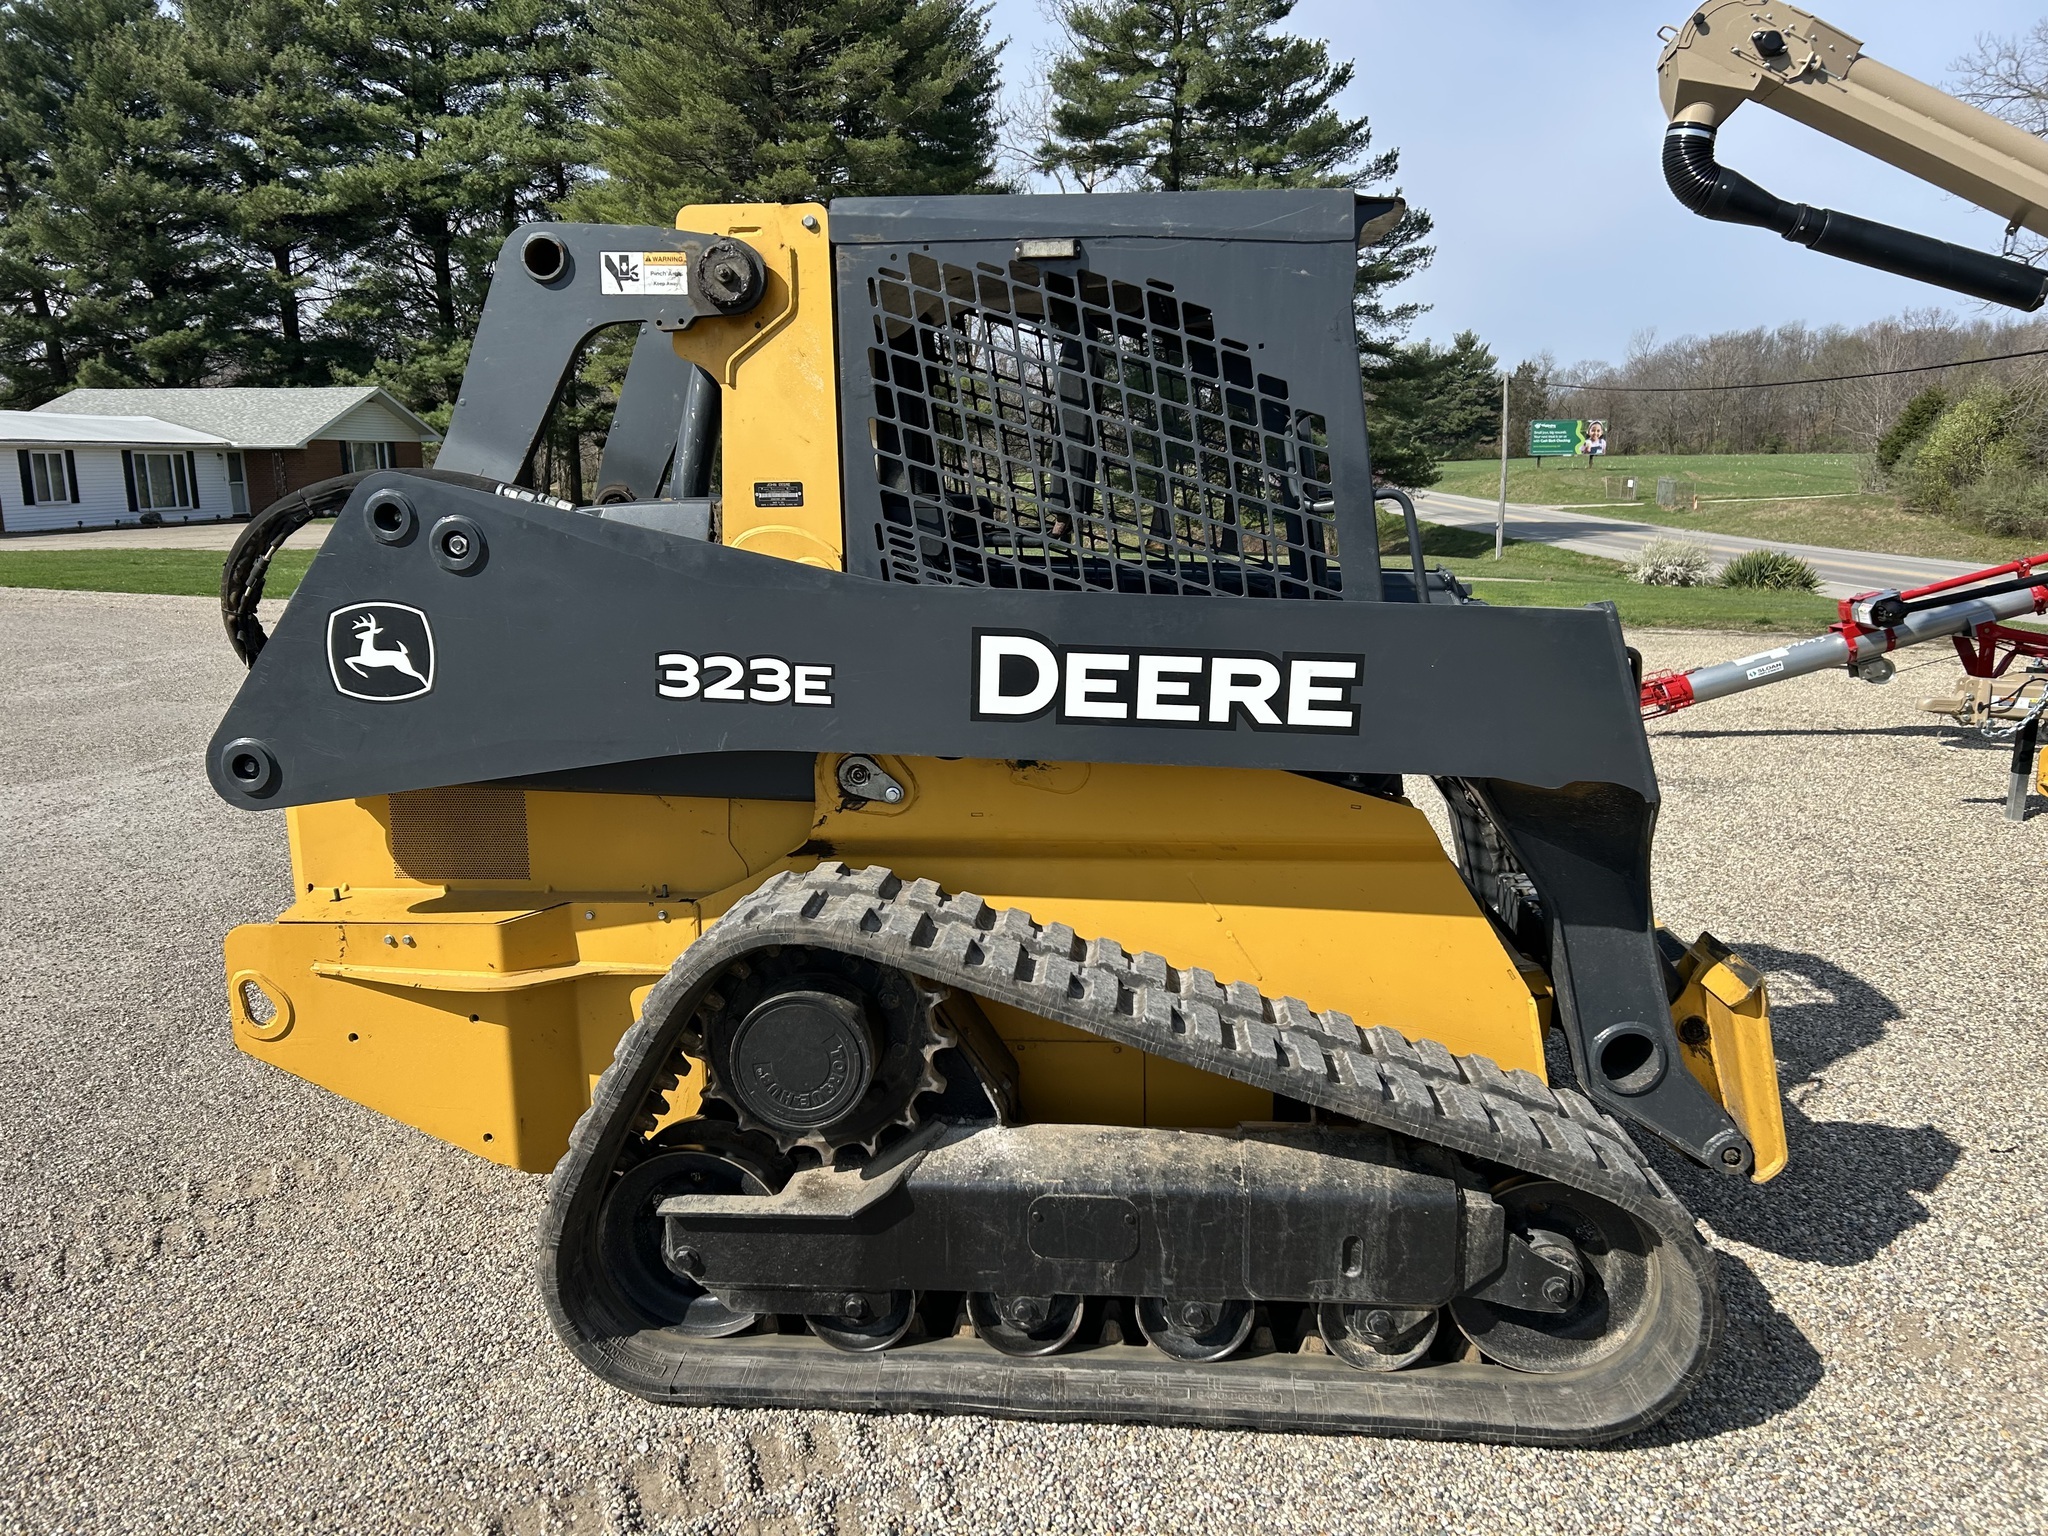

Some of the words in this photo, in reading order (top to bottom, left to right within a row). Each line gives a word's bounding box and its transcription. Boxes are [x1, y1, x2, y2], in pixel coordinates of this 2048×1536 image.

[659, 654, 831, 704] 323E
[980, 636, 1356, 726] DEERE
[1758, 663, 1781, 672] SLOAN
